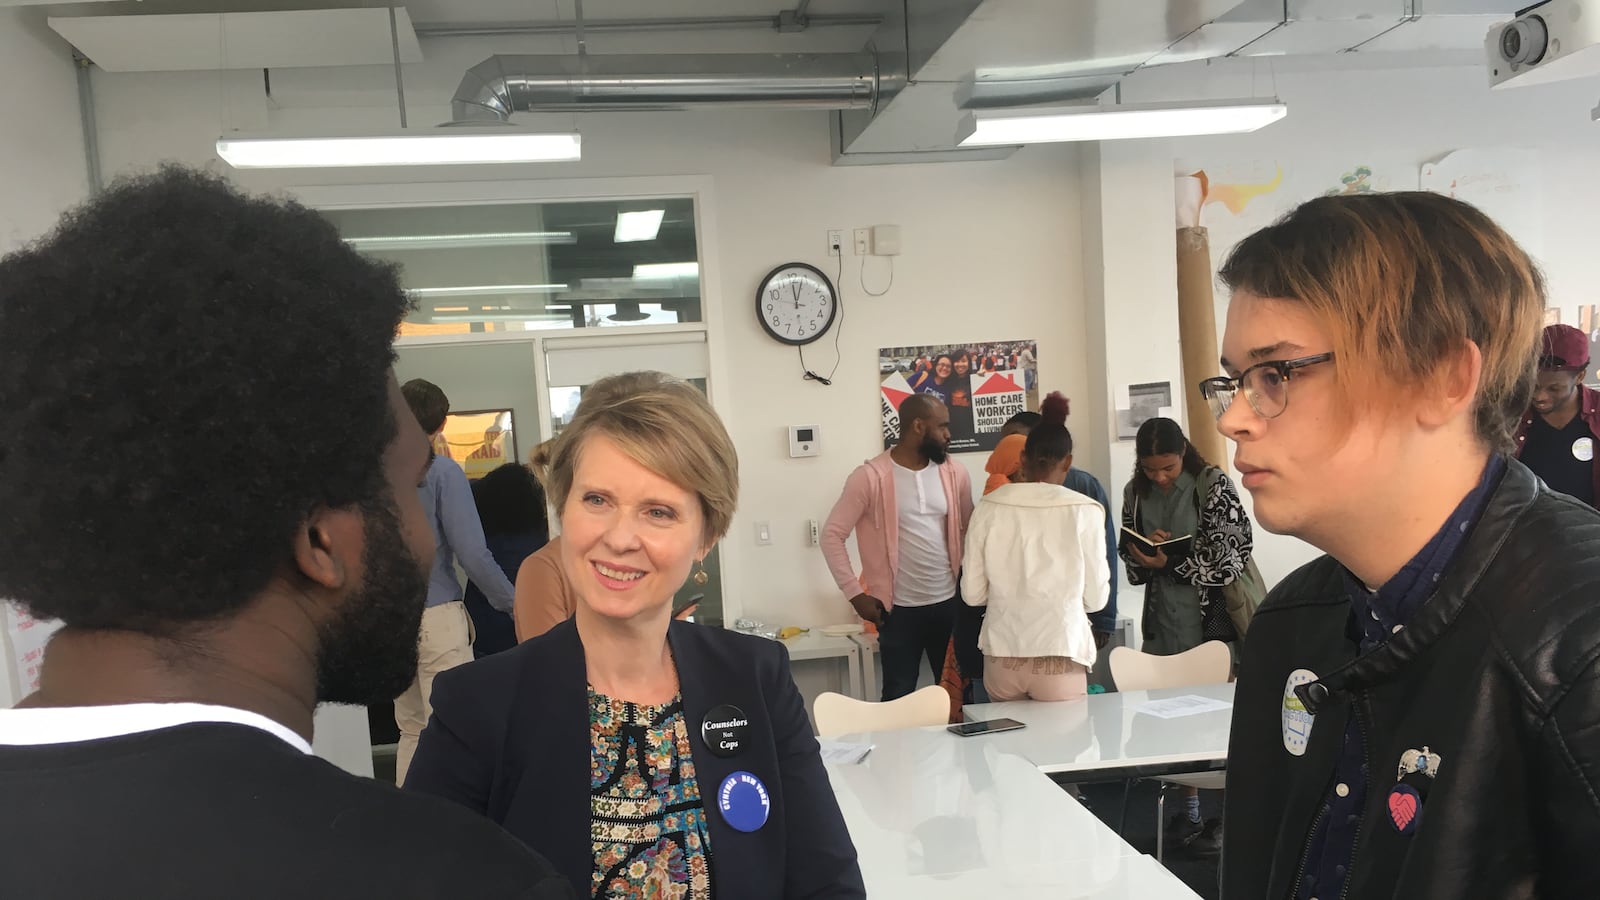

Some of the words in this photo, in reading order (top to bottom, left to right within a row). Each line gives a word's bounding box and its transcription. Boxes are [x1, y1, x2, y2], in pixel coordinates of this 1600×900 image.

[769, 289, 780, 301] 10
[819, 295, 827, 306] 3
[766, 304, 774, 314] 9
[816, 309, 824, 318] 4
[773, 315, 780, 327] 8
[810, 320, 816, 331] 5
[785, 324, 791, 335] 7
[798, 325, 805, 336] 6
[975, 396, 998, 407] HOME
[1000, 394, 1023, 405] CARE
[976, 405, 1024, 418] WORKERS
[977, 417, 1004, 426] SHOULD
[704, 718, 748, 730] Counselors
[719, 740, 739, 751] Cops
[722, 777, 738, 811] CYNTHIA
[741, 774, 757, 786] NEW
[755, 783, 768, 806] YORK
